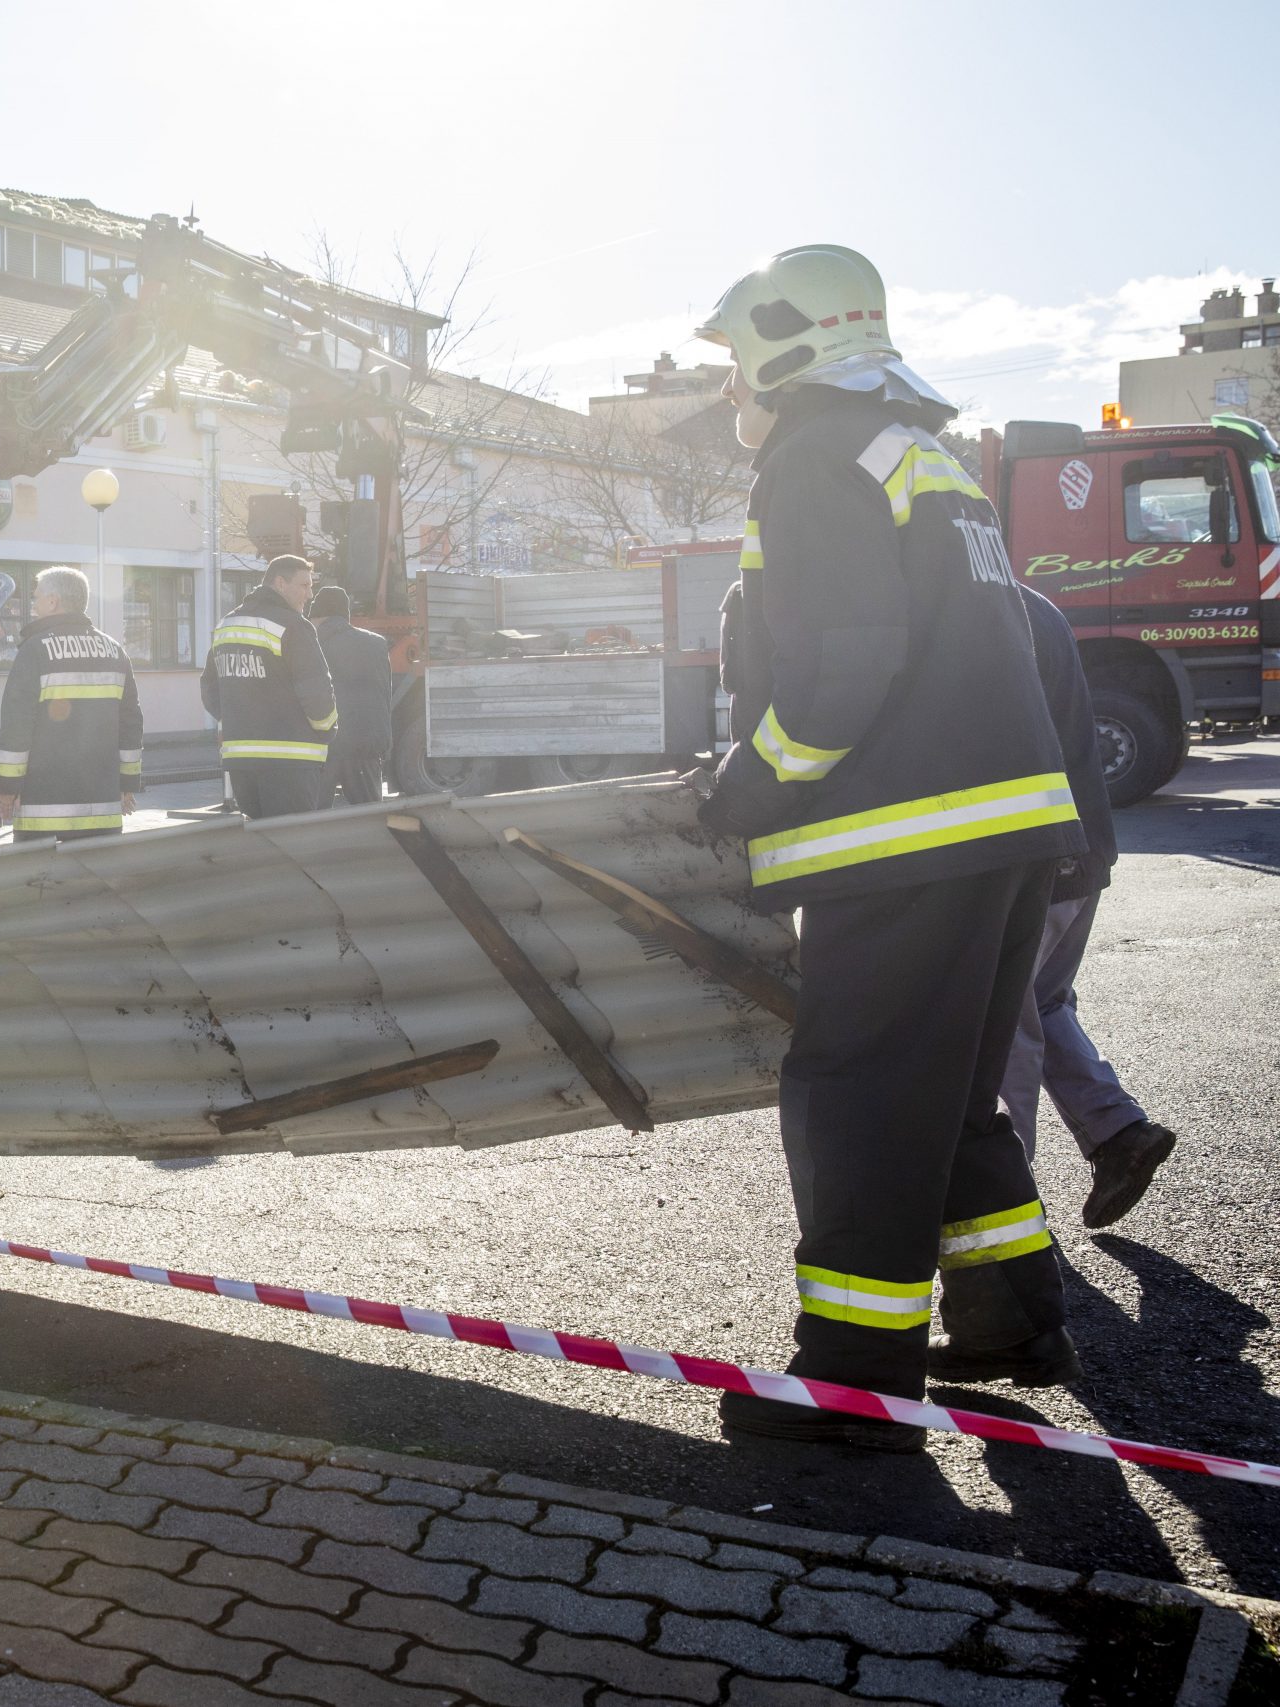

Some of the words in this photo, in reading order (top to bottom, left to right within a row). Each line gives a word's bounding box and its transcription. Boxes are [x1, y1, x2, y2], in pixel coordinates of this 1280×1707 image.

[1024, 547, 1192, 576] Benkő
[1189, 606, 1249, 618] 3348
[1140, 626, 1260, 641] 06-30/903-6326
